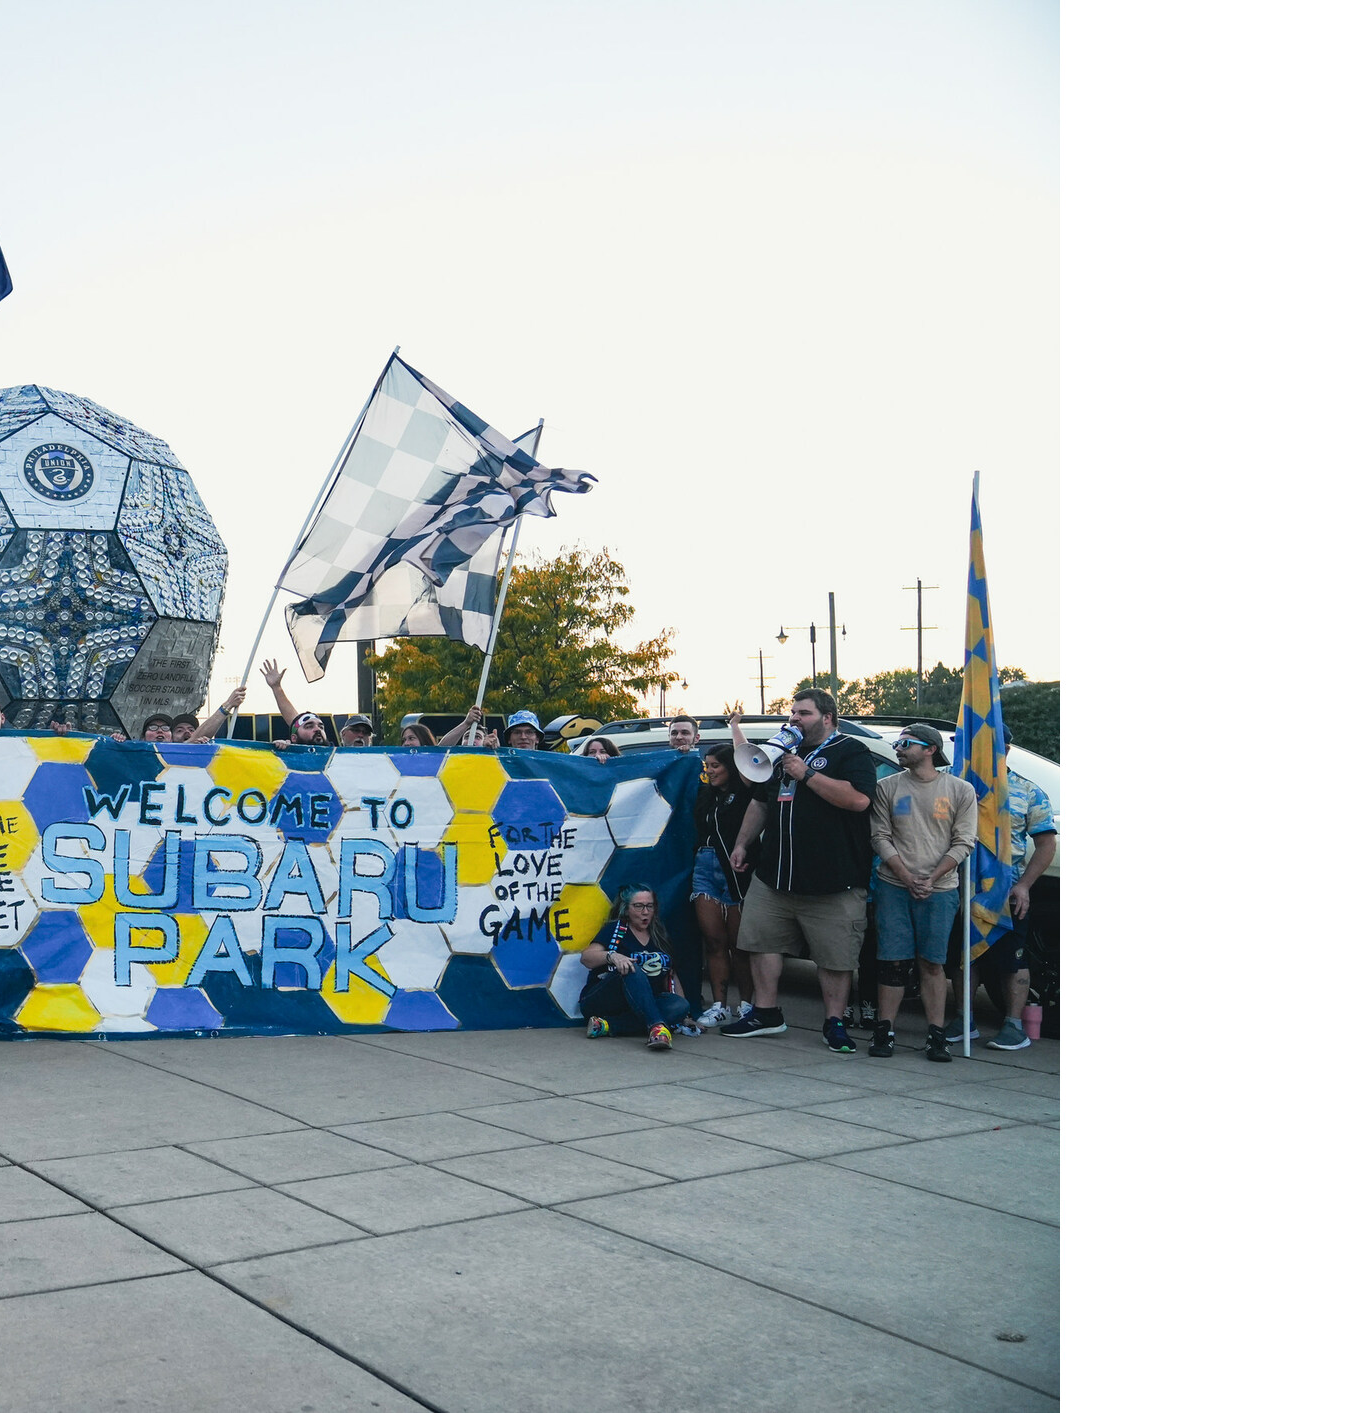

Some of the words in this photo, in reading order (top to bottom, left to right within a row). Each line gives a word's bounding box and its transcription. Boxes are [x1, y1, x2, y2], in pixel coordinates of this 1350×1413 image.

[25, 444, 90, 470] PHILADELPHIA
[44, 459, 71, 467] UNION
[136, 672, 158, 680] ZERO
[160, 674, 194, 682] LANDFILL
[152, 659, 167, 668] THE
[170, 660, 191, 669] FIRST
[128, 684, 160, 693] SOCCER
[161, 686, 194, 695] STADIUM
[82, 781, 333, 830] WELCOME
[360, 797, 415, 831] TO
[41, 821, 459, 926] SUBARU
[494, 851, 563, 877] LOVE
[495, 881, 520, 901] OF
[522, 882, 563, 902] THE
[479, 904, 573, 946] GAME
[114, 912, 398, 999] PARK
